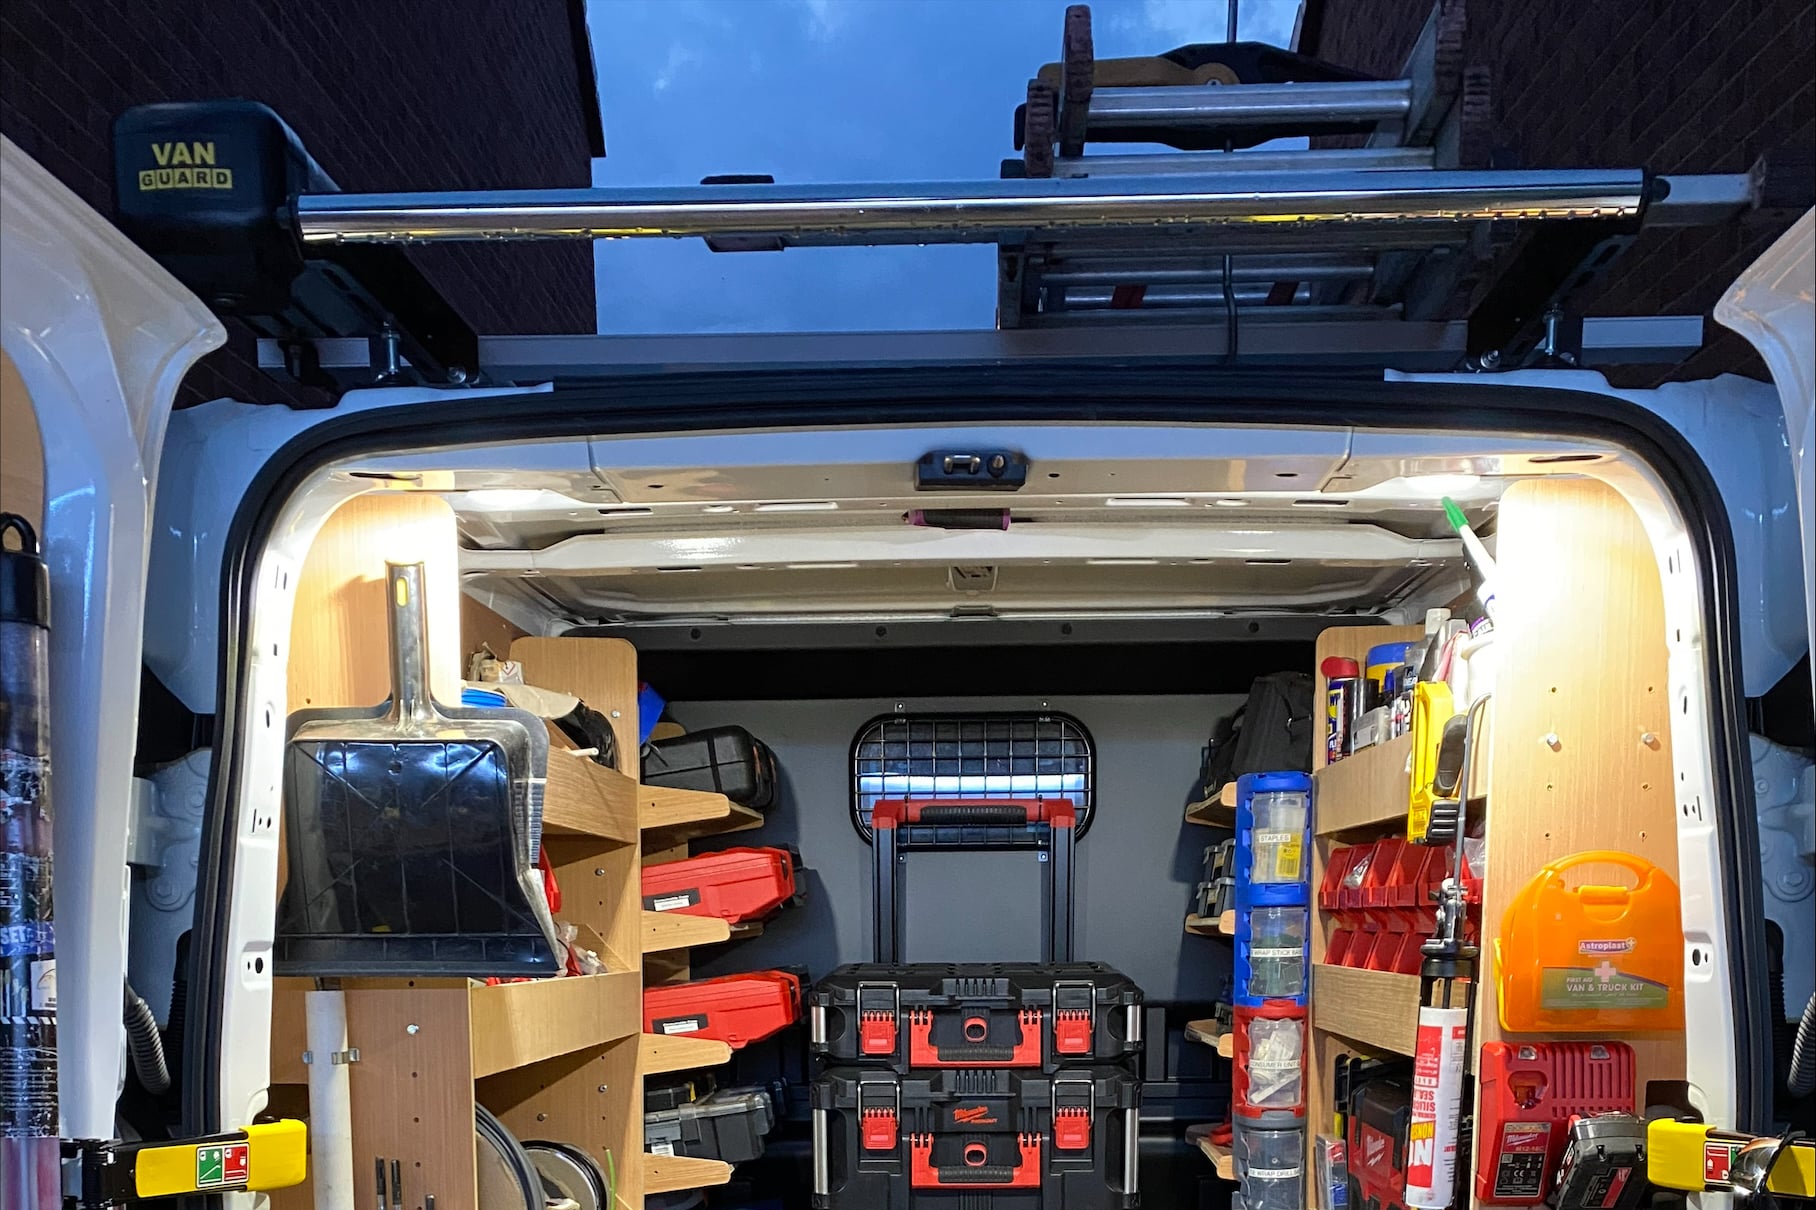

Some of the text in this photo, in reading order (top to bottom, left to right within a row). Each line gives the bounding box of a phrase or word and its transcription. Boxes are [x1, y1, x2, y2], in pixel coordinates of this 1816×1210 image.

[151, 142, 215, 166] VAN
[141, 170, 228, 187] GUARD
[1260, 834, 1290, 842] STAPLES
[1579, 941, 1626, 951] Astroplast
[1254, 948, 1271, 956] WRAP
[1271, 948, 1290, 956] STICK
[1566, 983, 1644, 992] VAN & TRUCK KIT
